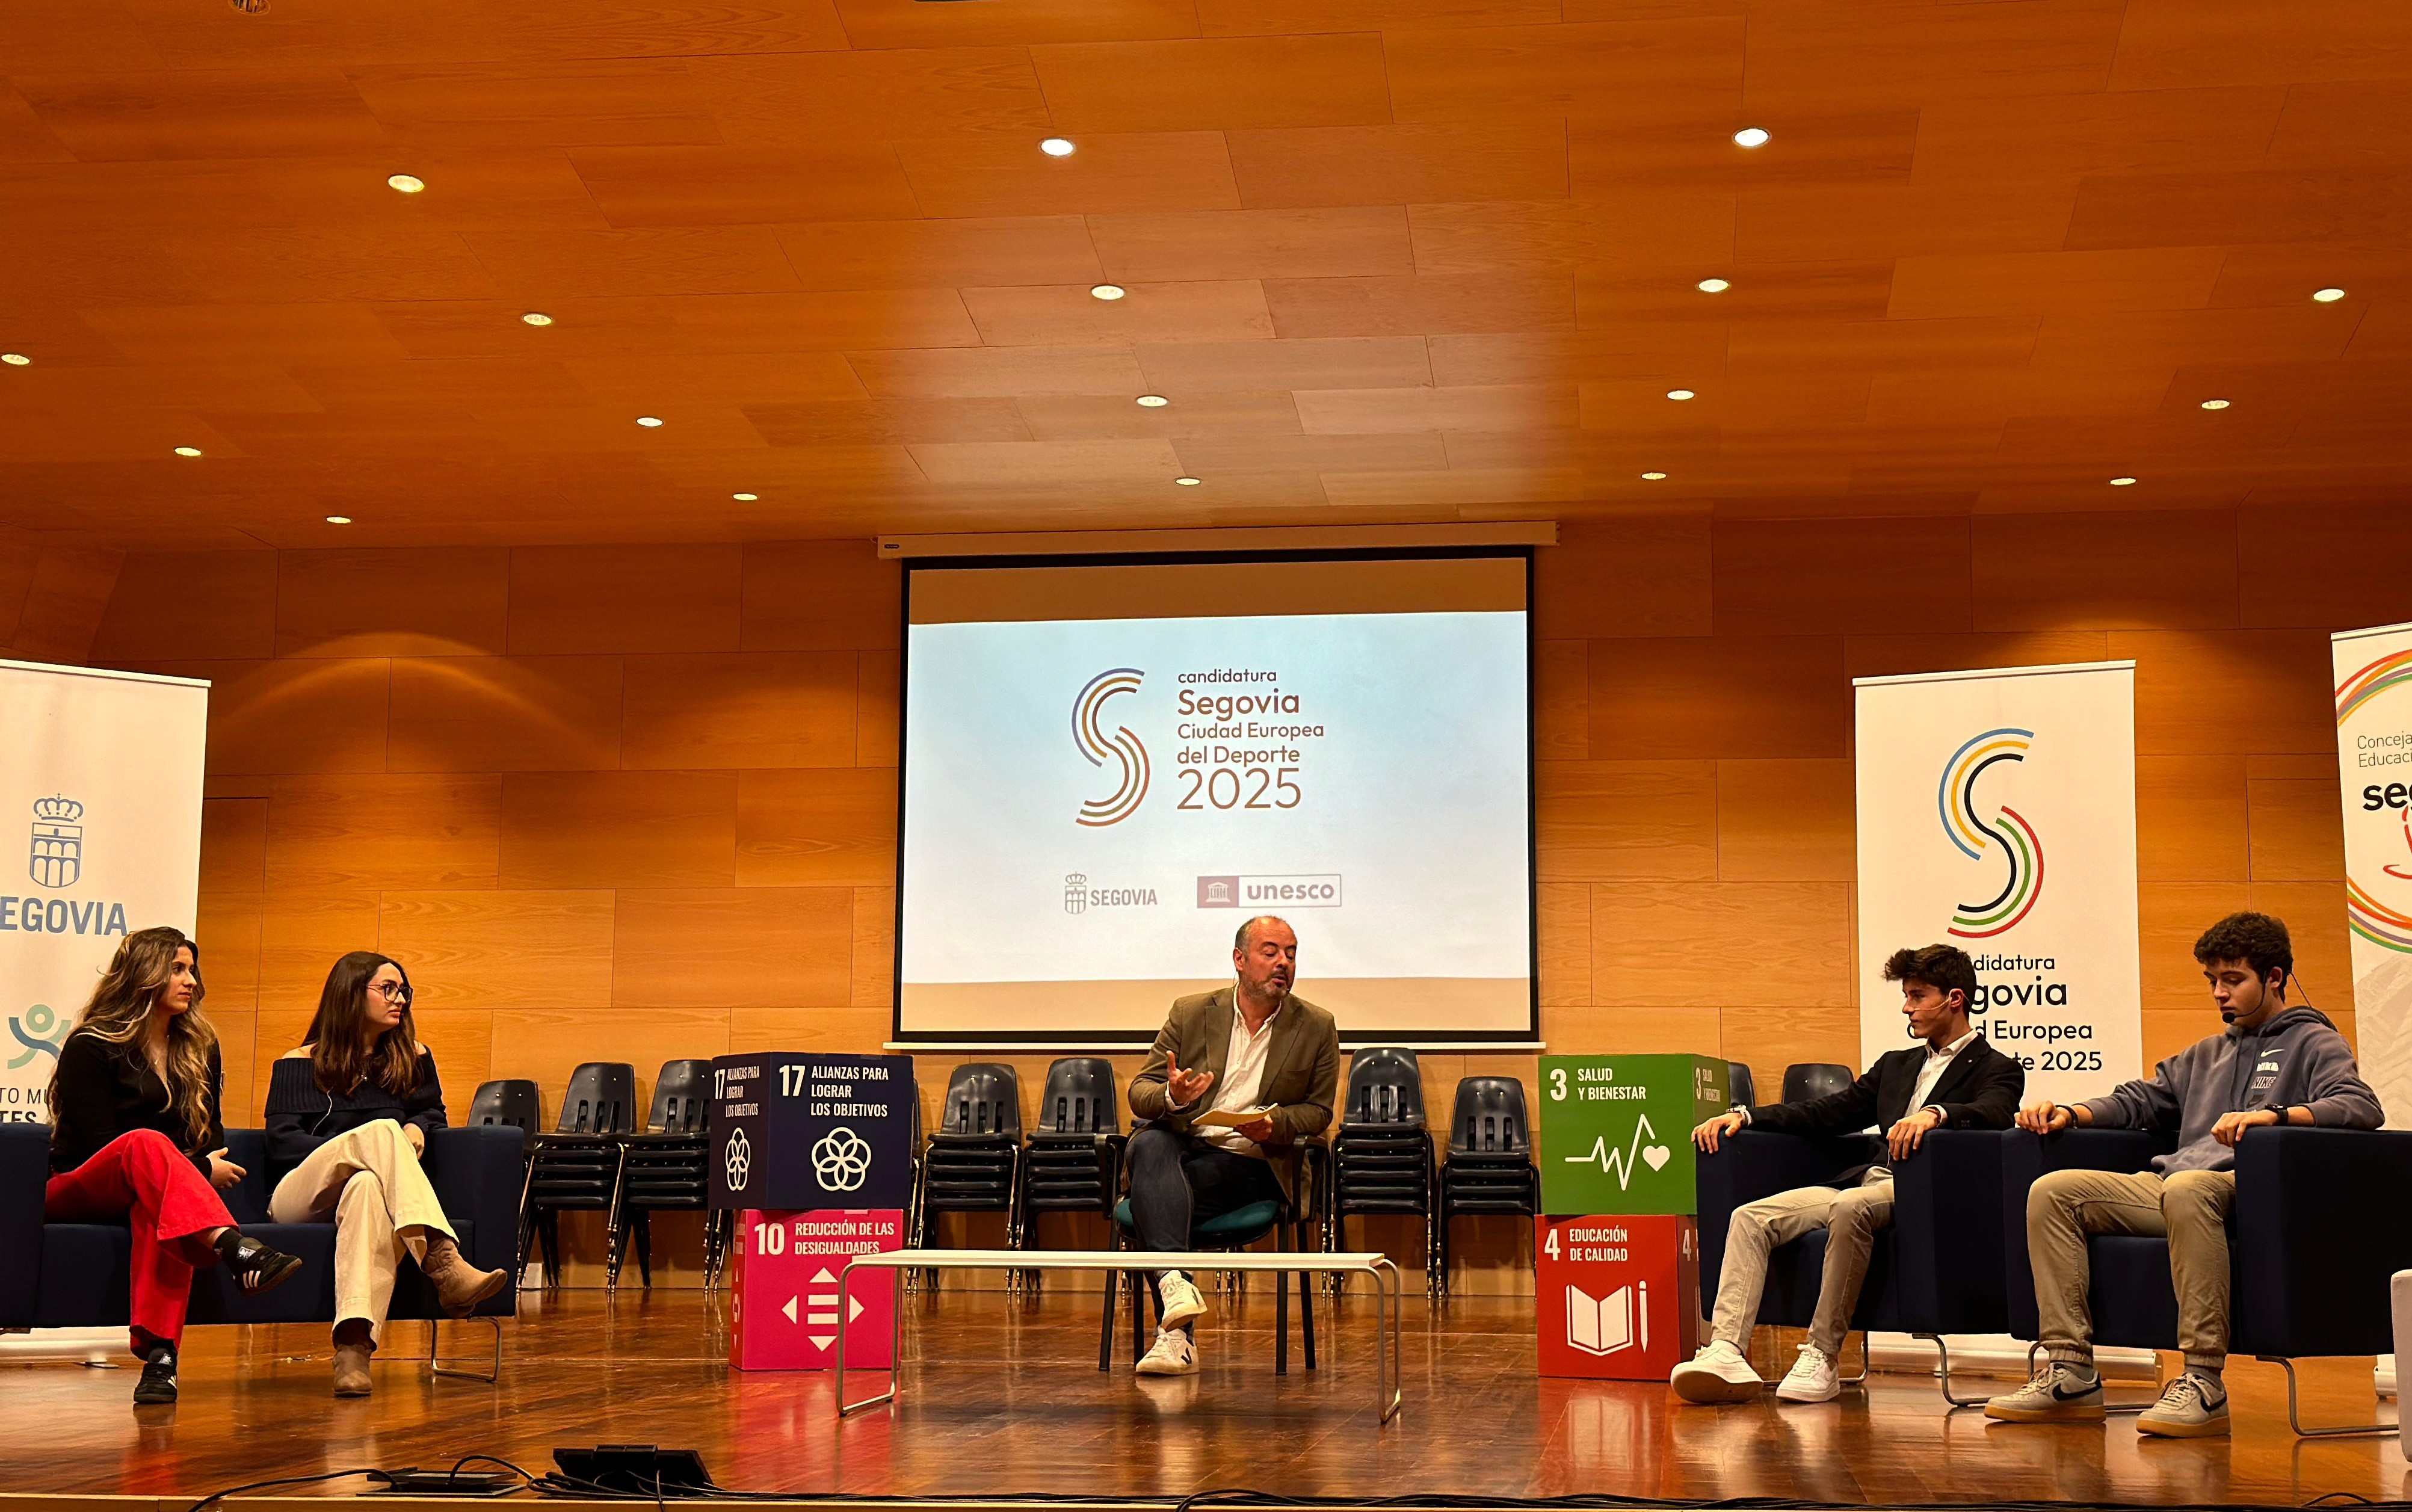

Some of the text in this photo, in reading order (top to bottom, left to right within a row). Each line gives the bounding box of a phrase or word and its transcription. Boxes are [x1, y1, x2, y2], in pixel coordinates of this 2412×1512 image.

[1177, 668, 1277, 683] candidatura
[1177, 688, 1300, 721] Segovia
[1177, 723, 1324, 741] Ciudad Europea
[2357, 730, 2412, 749] Conceja
[1177, 745, 1300, 768] del Deporte
[2358, 748, 2412, 767] Educaci
[1177, 767, 1301, 810] 2025
[1090, 889, 1158, 906] SEGOVIA
[1247, 883, 1334, 900] unesco
[0, 896, 128, 936] EGOVIA
[1973, 954, 2055, 971] didatura
[1971, 975, 2067, 1014] govia
[1994, 1020, 2093, 1045] Europea
[2041, 1051, 2102, 1071] 2025
[748, 1066, 760, 1079] PARA
[779, 1064, 806, 1097] 17
[812, 1066, 889, 1081] ALIANZAS PARA
[1578, 1067, 1613, 1081] SALUD
[714, 1069, 726, 1100] 17
[811, 1084, 852, 1098] LOGRAR
[1549, 1069, 1567, 1101] 3
[1695, 1067, 1701, 1100] 3
[1578, 1086, 1647, 1100] Y BIENESTAR
[726, 1103, 759, 1117] LOS OBJETIVOS
[810, 1103, 888, 1117] LOS OBJETIVOS
[795, 1219, 895, 1236] REDUCCIÓN DE LAS
[1569, 1225, 1627, 1242] EDUCACIÓN
[754, 1223, 785, 1255] 10
[795, 1241, 880, 1255] DESIGUALDADES
[1544, 1228, 1561, 1261] 4
[1682, 1229, 1691, 1262] 4
[1570, 1247, 1627, 1262] DE CALIDAD
